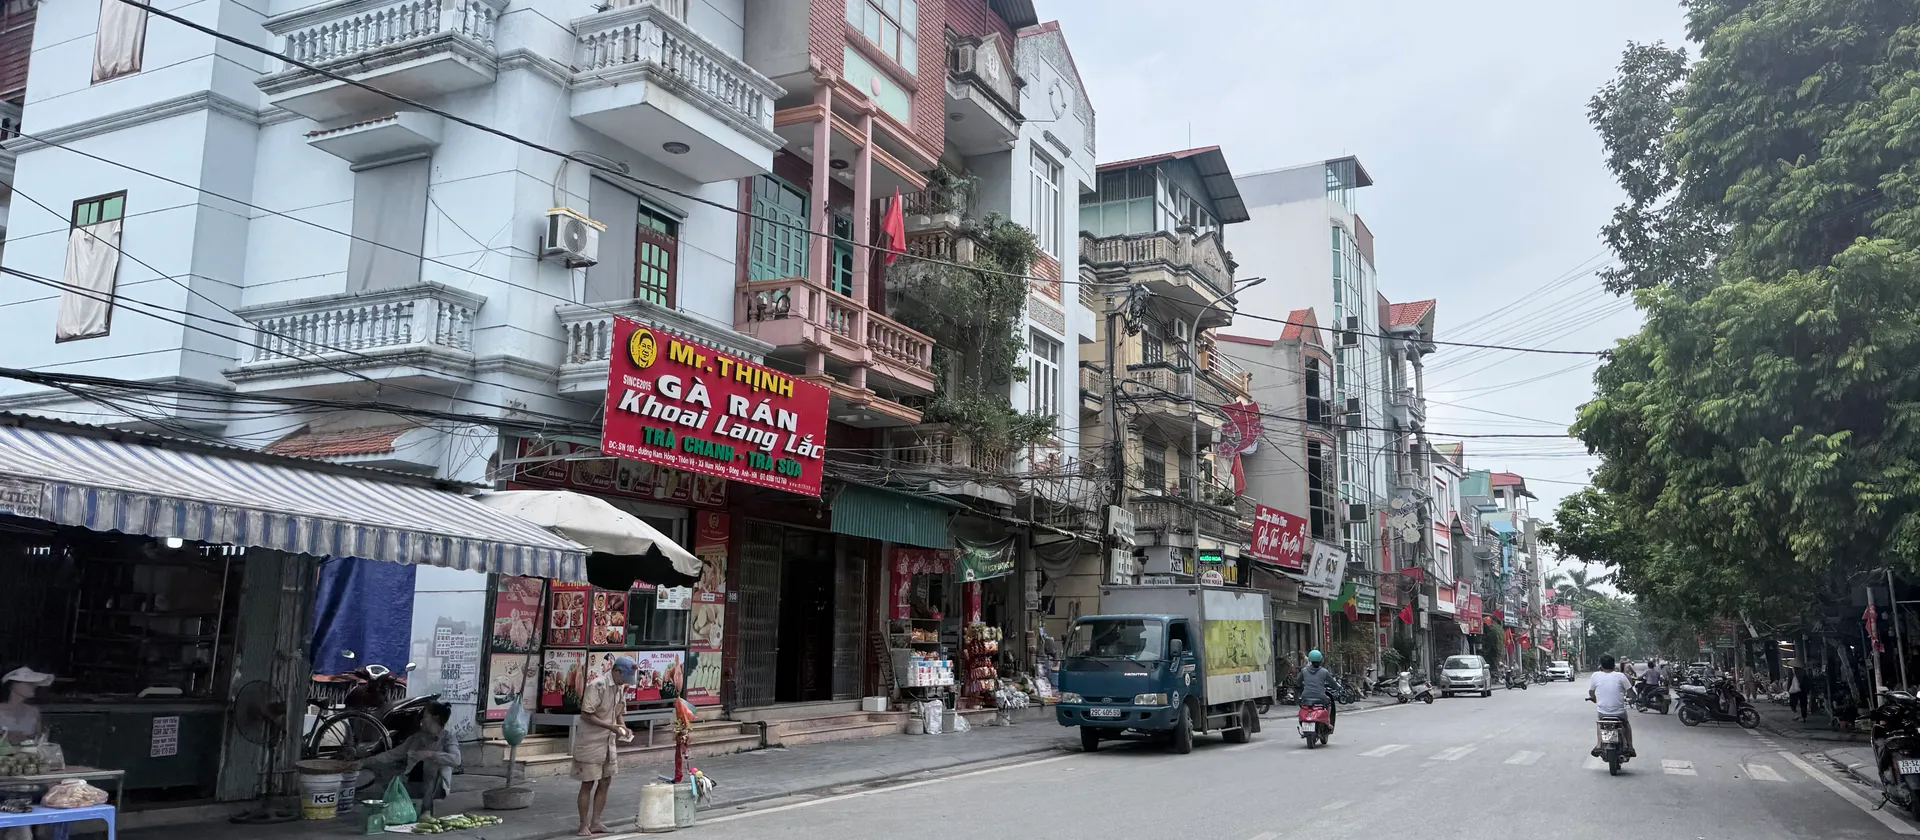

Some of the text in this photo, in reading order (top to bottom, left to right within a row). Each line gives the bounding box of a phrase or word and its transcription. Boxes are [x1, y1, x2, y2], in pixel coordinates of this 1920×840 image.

[670, 340, 794, 398] Mr. THỊNH
[618, 390, 824, 459] Khoai Lang Lắc
[658, 374, 798, 432] GÀ RÁN
[643, 425, 675, 449] TRÀ
[682, 436, 735, 462] CHANH
[747, 450, 773, 470] TRÀ
[653, 449, 663, 459] Nam
